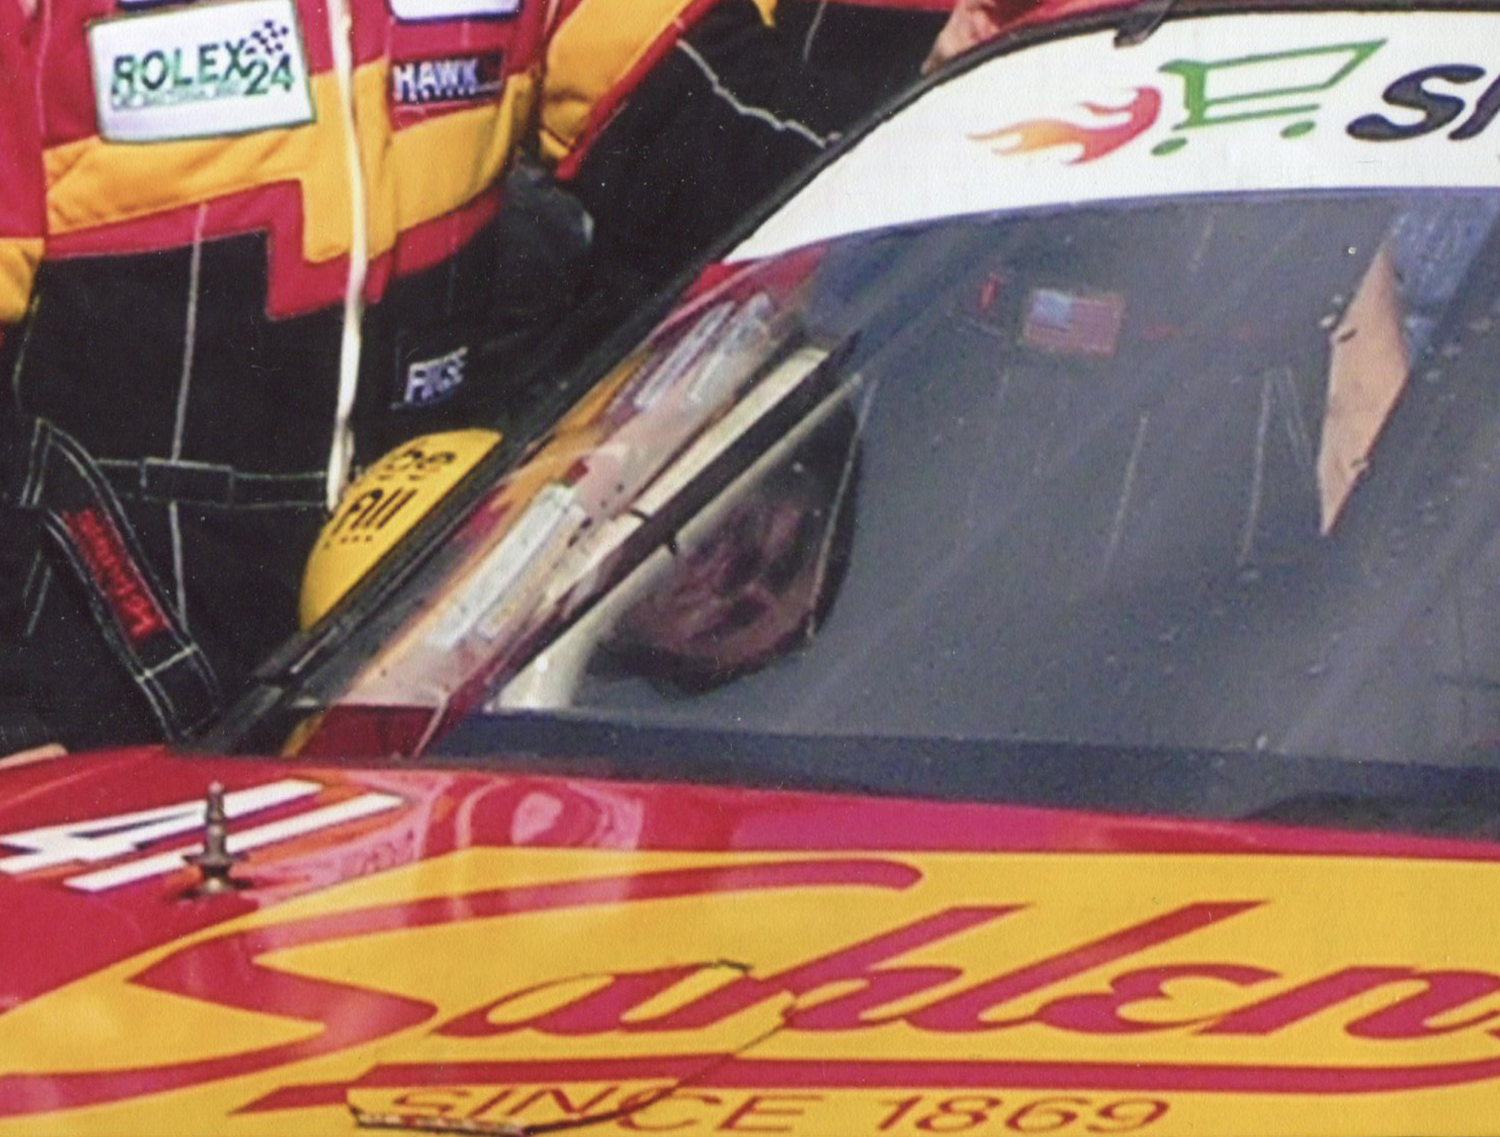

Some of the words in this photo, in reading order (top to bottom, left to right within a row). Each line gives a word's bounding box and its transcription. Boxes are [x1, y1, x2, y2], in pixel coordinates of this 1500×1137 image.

[111, 38, 247, 97] ROLEX
[243, 53, 297, 97] 24
[392, 59, 478, 102] HAWK
[392, 1086, 826, 1132] SINCE
[875, 1095, 1172, 1134] 1869
